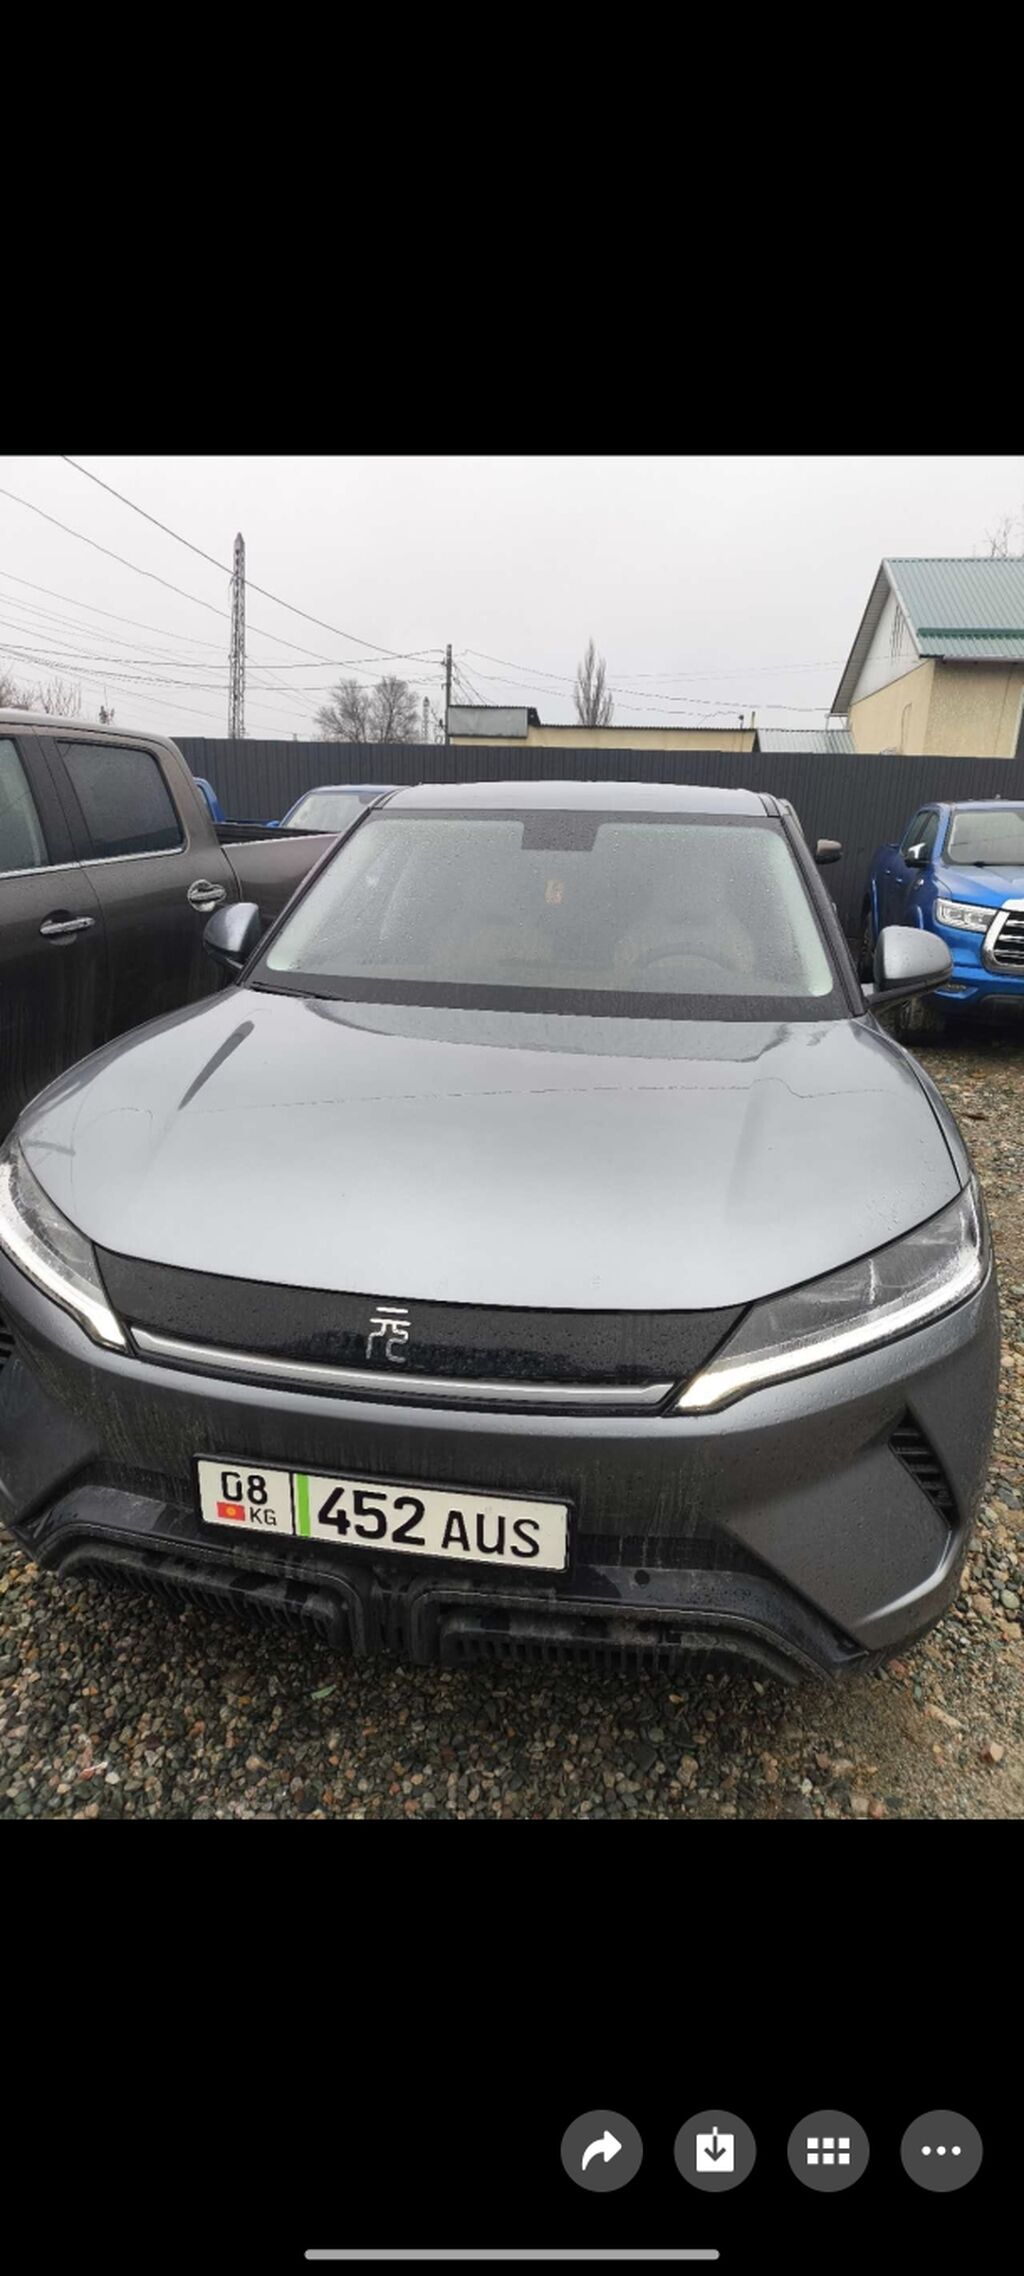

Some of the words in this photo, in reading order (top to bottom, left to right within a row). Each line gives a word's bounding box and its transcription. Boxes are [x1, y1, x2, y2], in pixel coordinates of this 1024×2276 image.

[221, 1471, 268, 1505] 08
[318, 1486, 425, 1546] 452
[441, 1510, 540, 1558] AUS
[249, 1506, 277, 1526] KG
